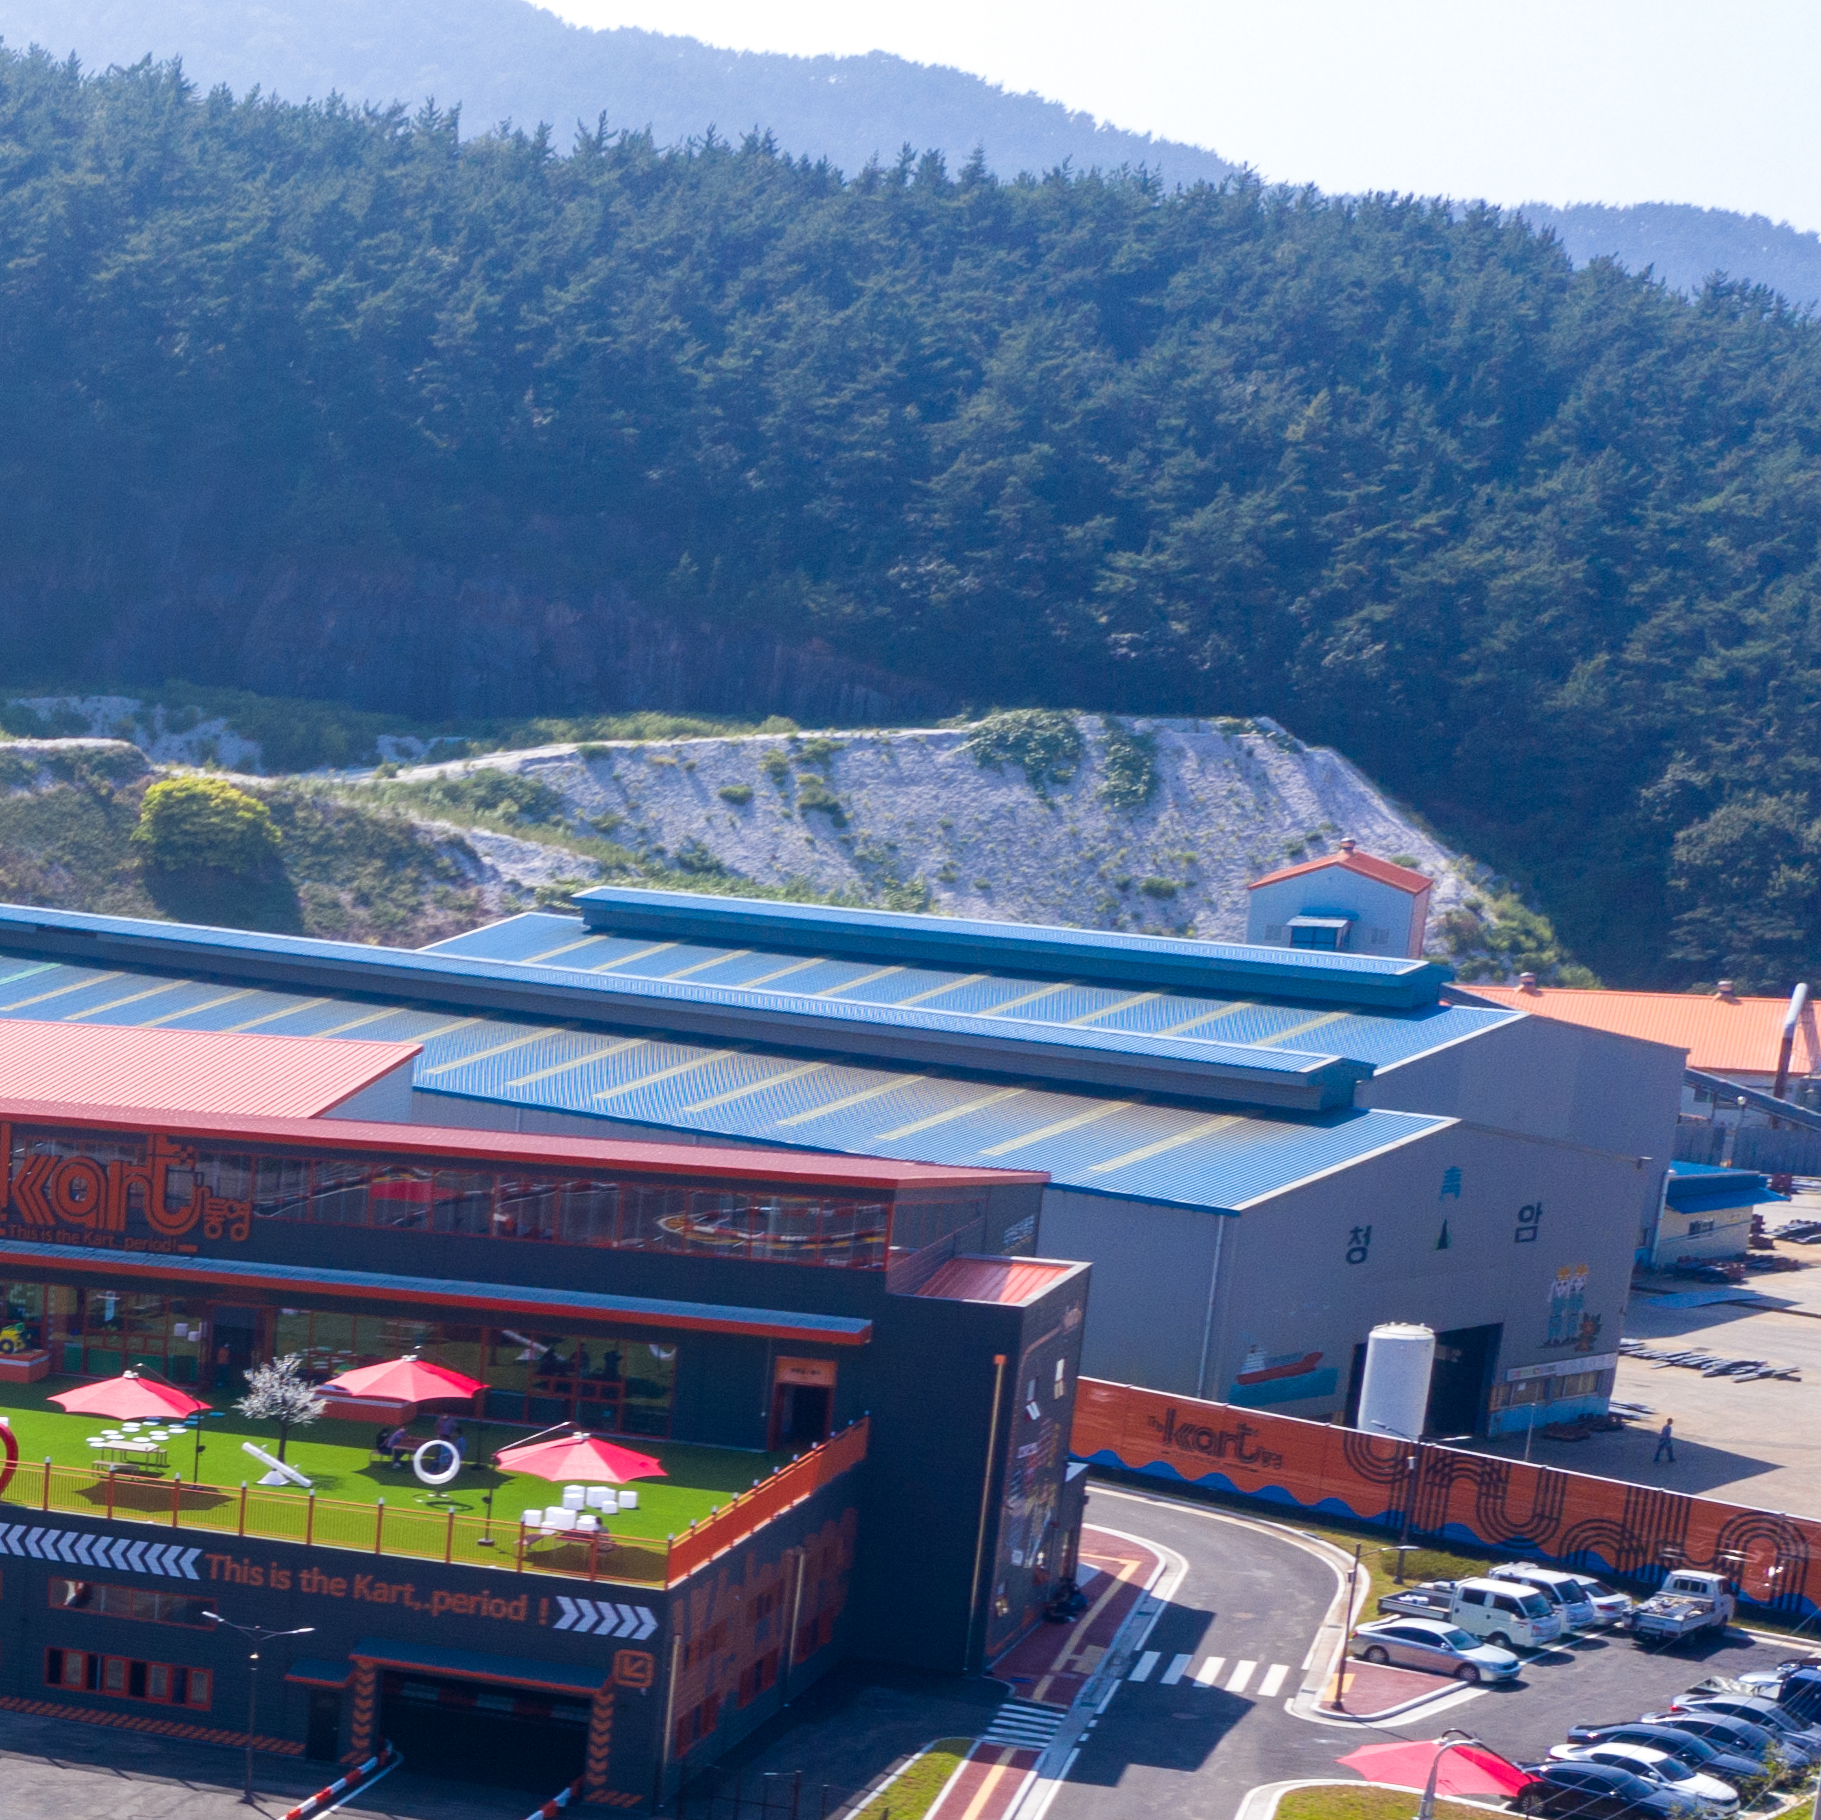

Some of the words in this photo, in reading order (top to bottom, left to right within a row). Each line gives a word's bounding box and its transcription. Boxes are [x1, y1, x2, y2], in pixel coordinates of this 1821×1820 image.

[9, 1224, 38, 1240] This
[57, 1229, 83, 1244] the
[205, 1553, 264, 1587] This
[269, 1561, 292, 1591] is
[299, 1566, 348, 1598] the
